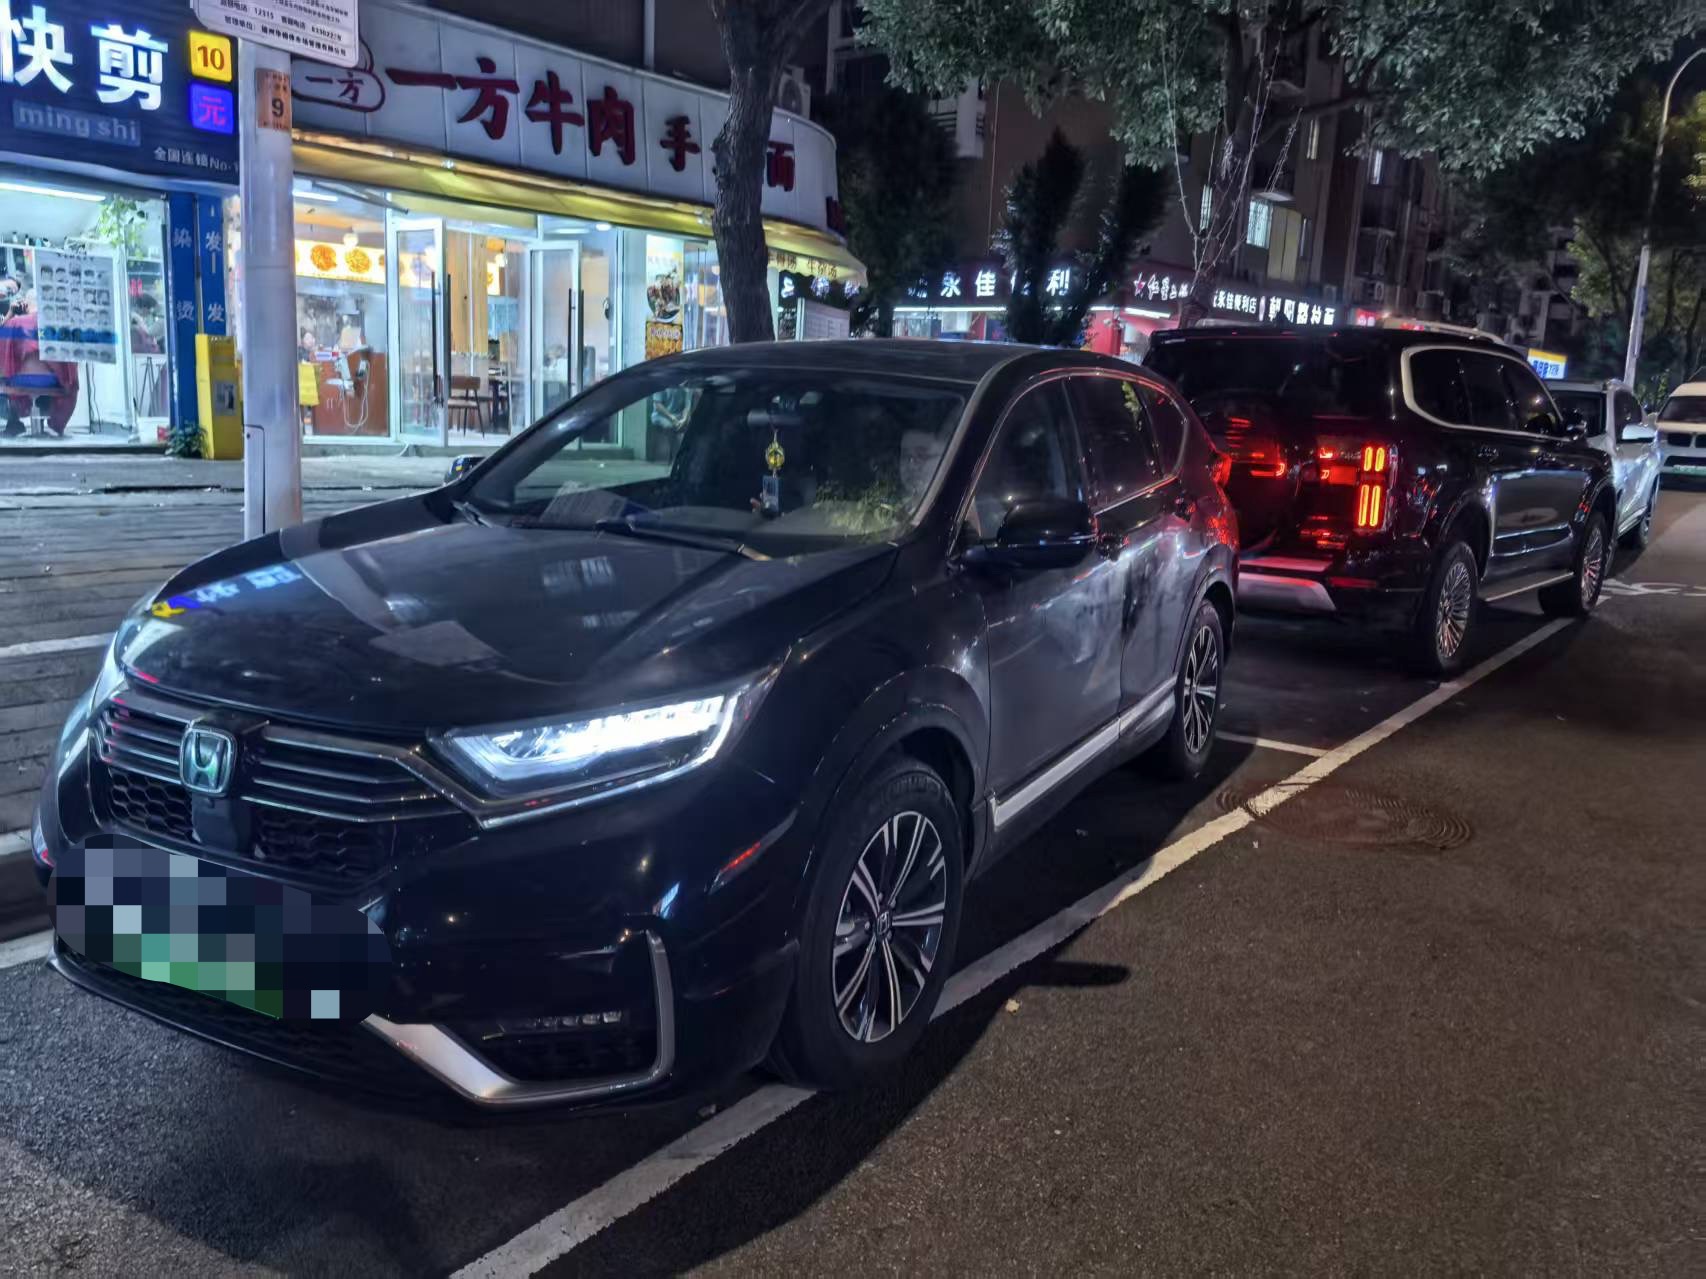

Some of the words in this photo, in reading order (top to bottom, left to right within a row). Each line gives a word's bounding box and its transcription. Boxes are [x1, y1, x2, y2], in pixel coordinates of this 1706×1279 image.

[0, 4, 169, 111] 快剪
[197, 45, 225, 70] 10
[305, 70, 364, 104] 一方
[18, 105, 90, 138] ming
[97, 117, 138, 141] shi
[199, 96, 225, 127] 元
[271, 97, 284, 118] 9
[386, 57, 795, 192] 一方牛肉手面
